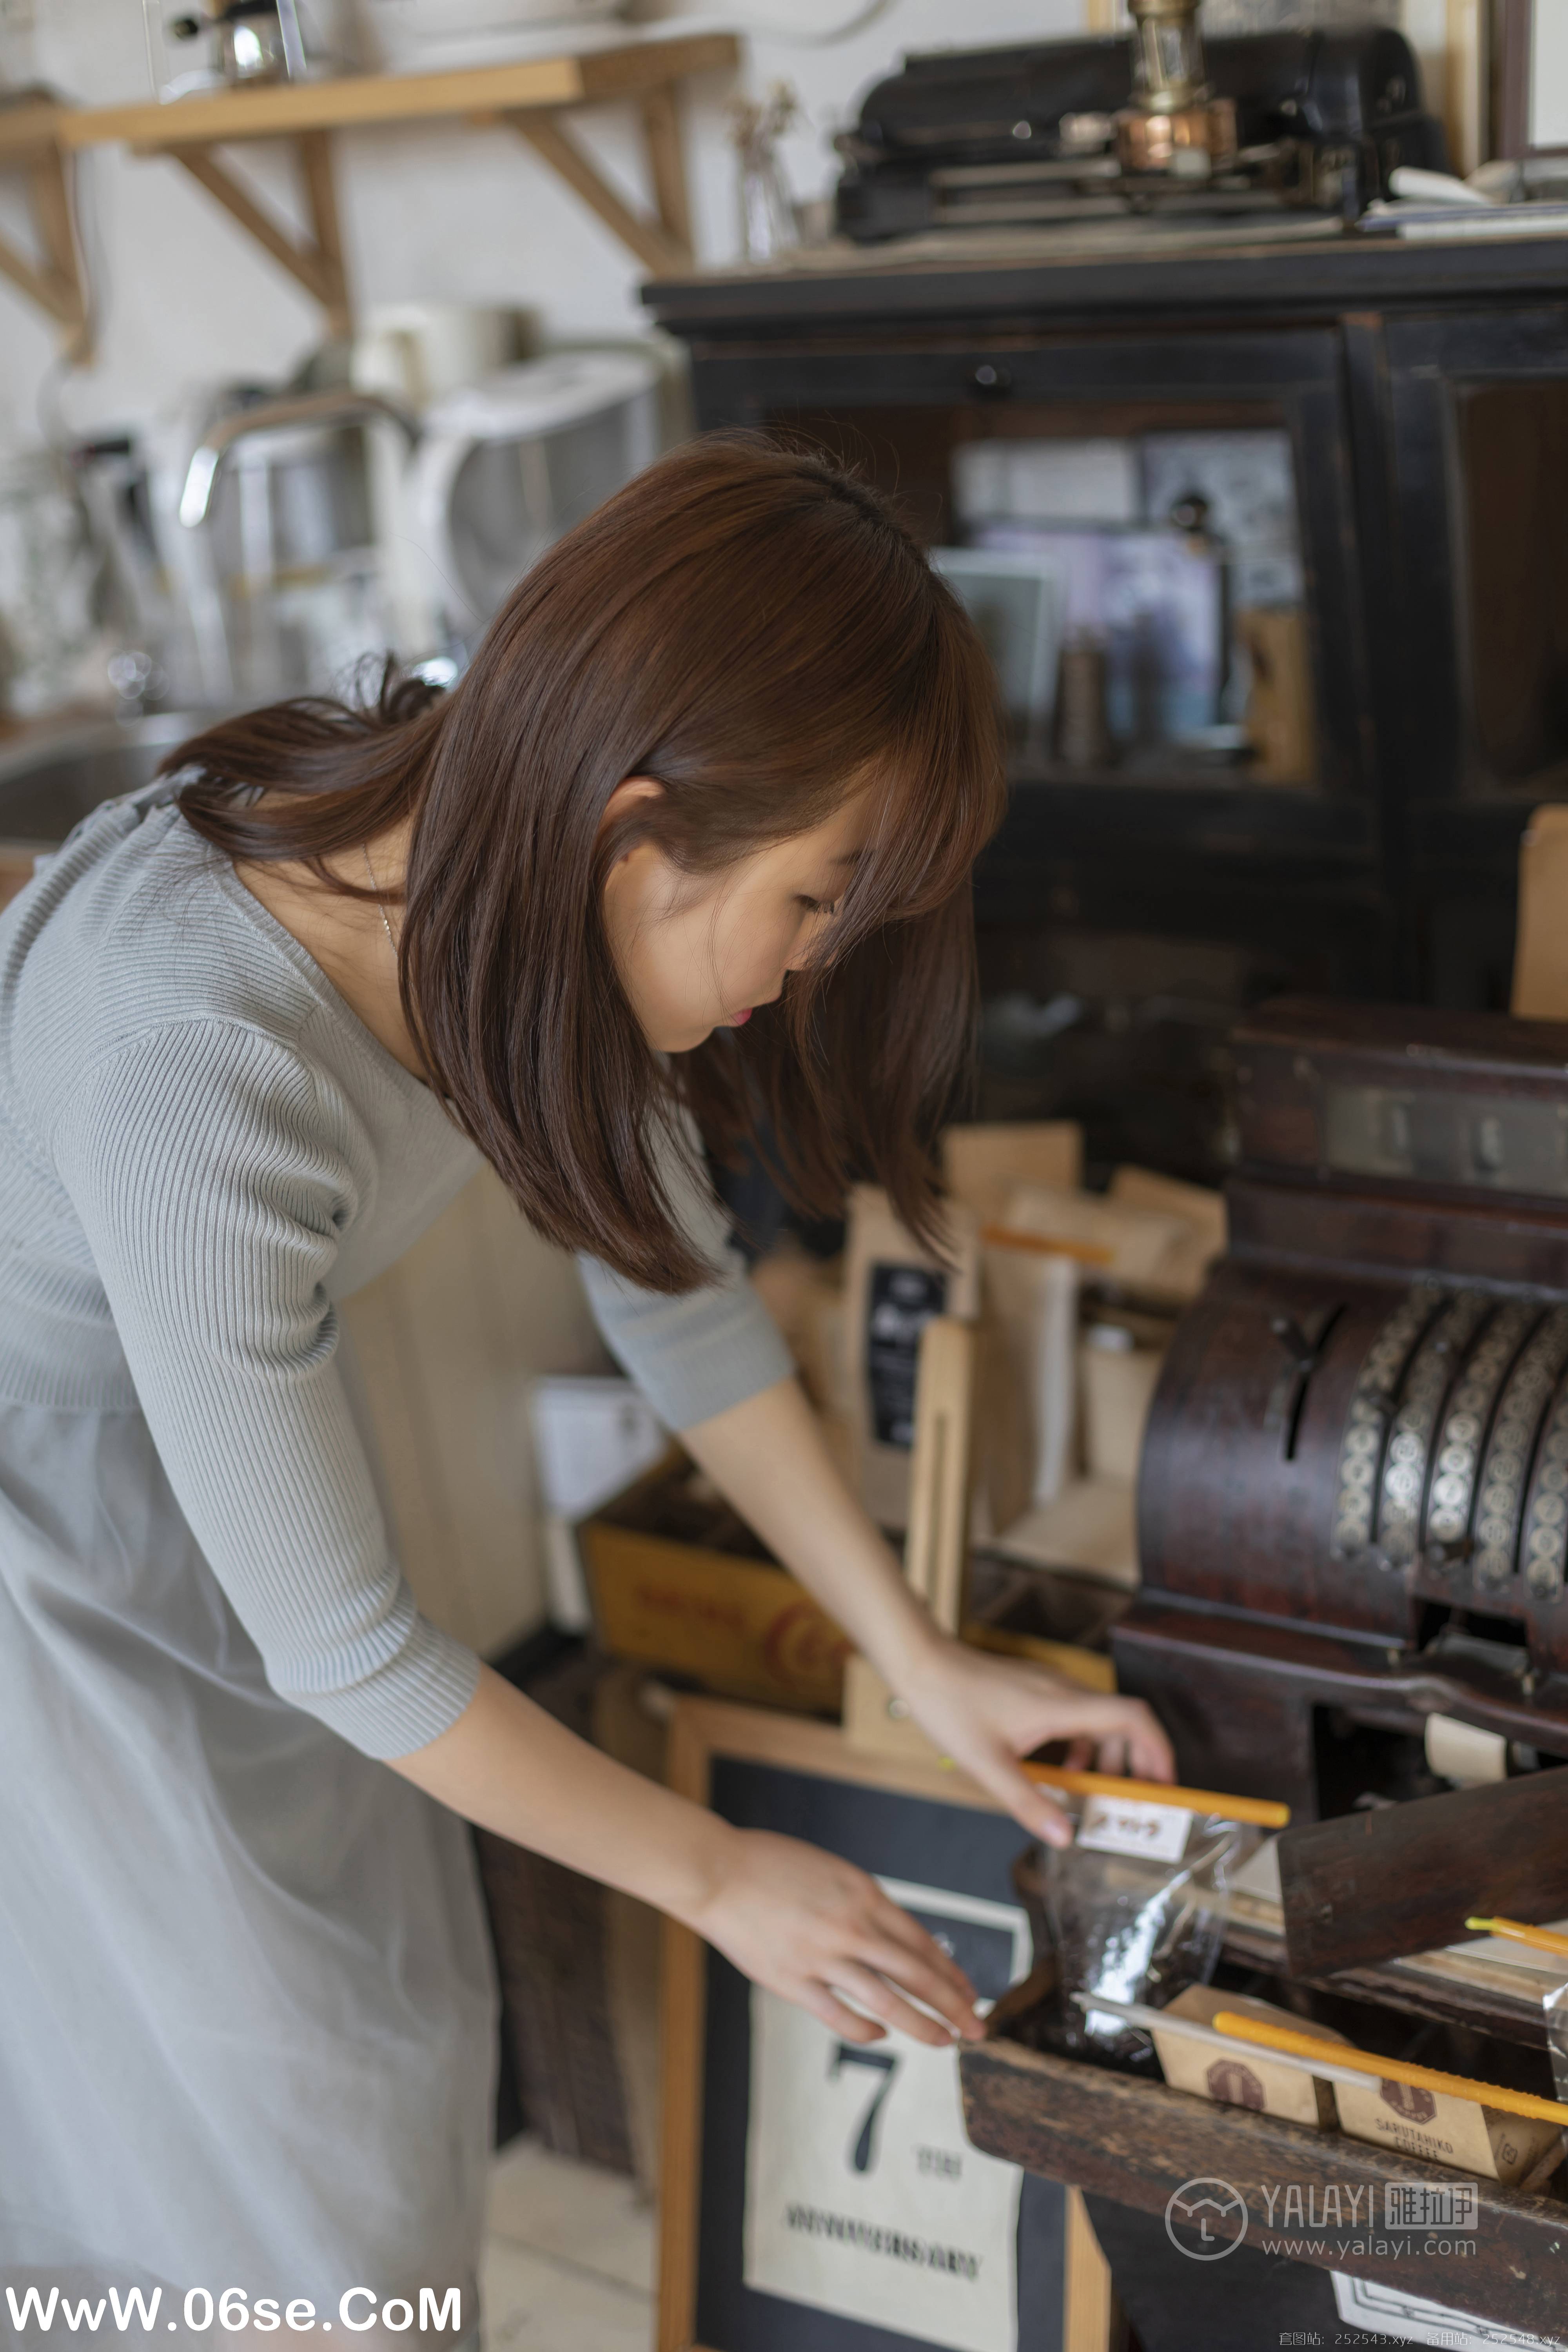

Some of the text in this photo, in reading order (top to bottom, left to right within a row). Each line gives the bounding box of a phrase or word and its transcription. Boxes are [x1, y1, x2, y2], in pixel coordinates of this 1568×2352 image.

[828, 2042, 902, 2178] 7
[1375, 2118, 1454, 2154] SARUTAHIKO
[1394, 2136, 1437, 2159] COFFEE
